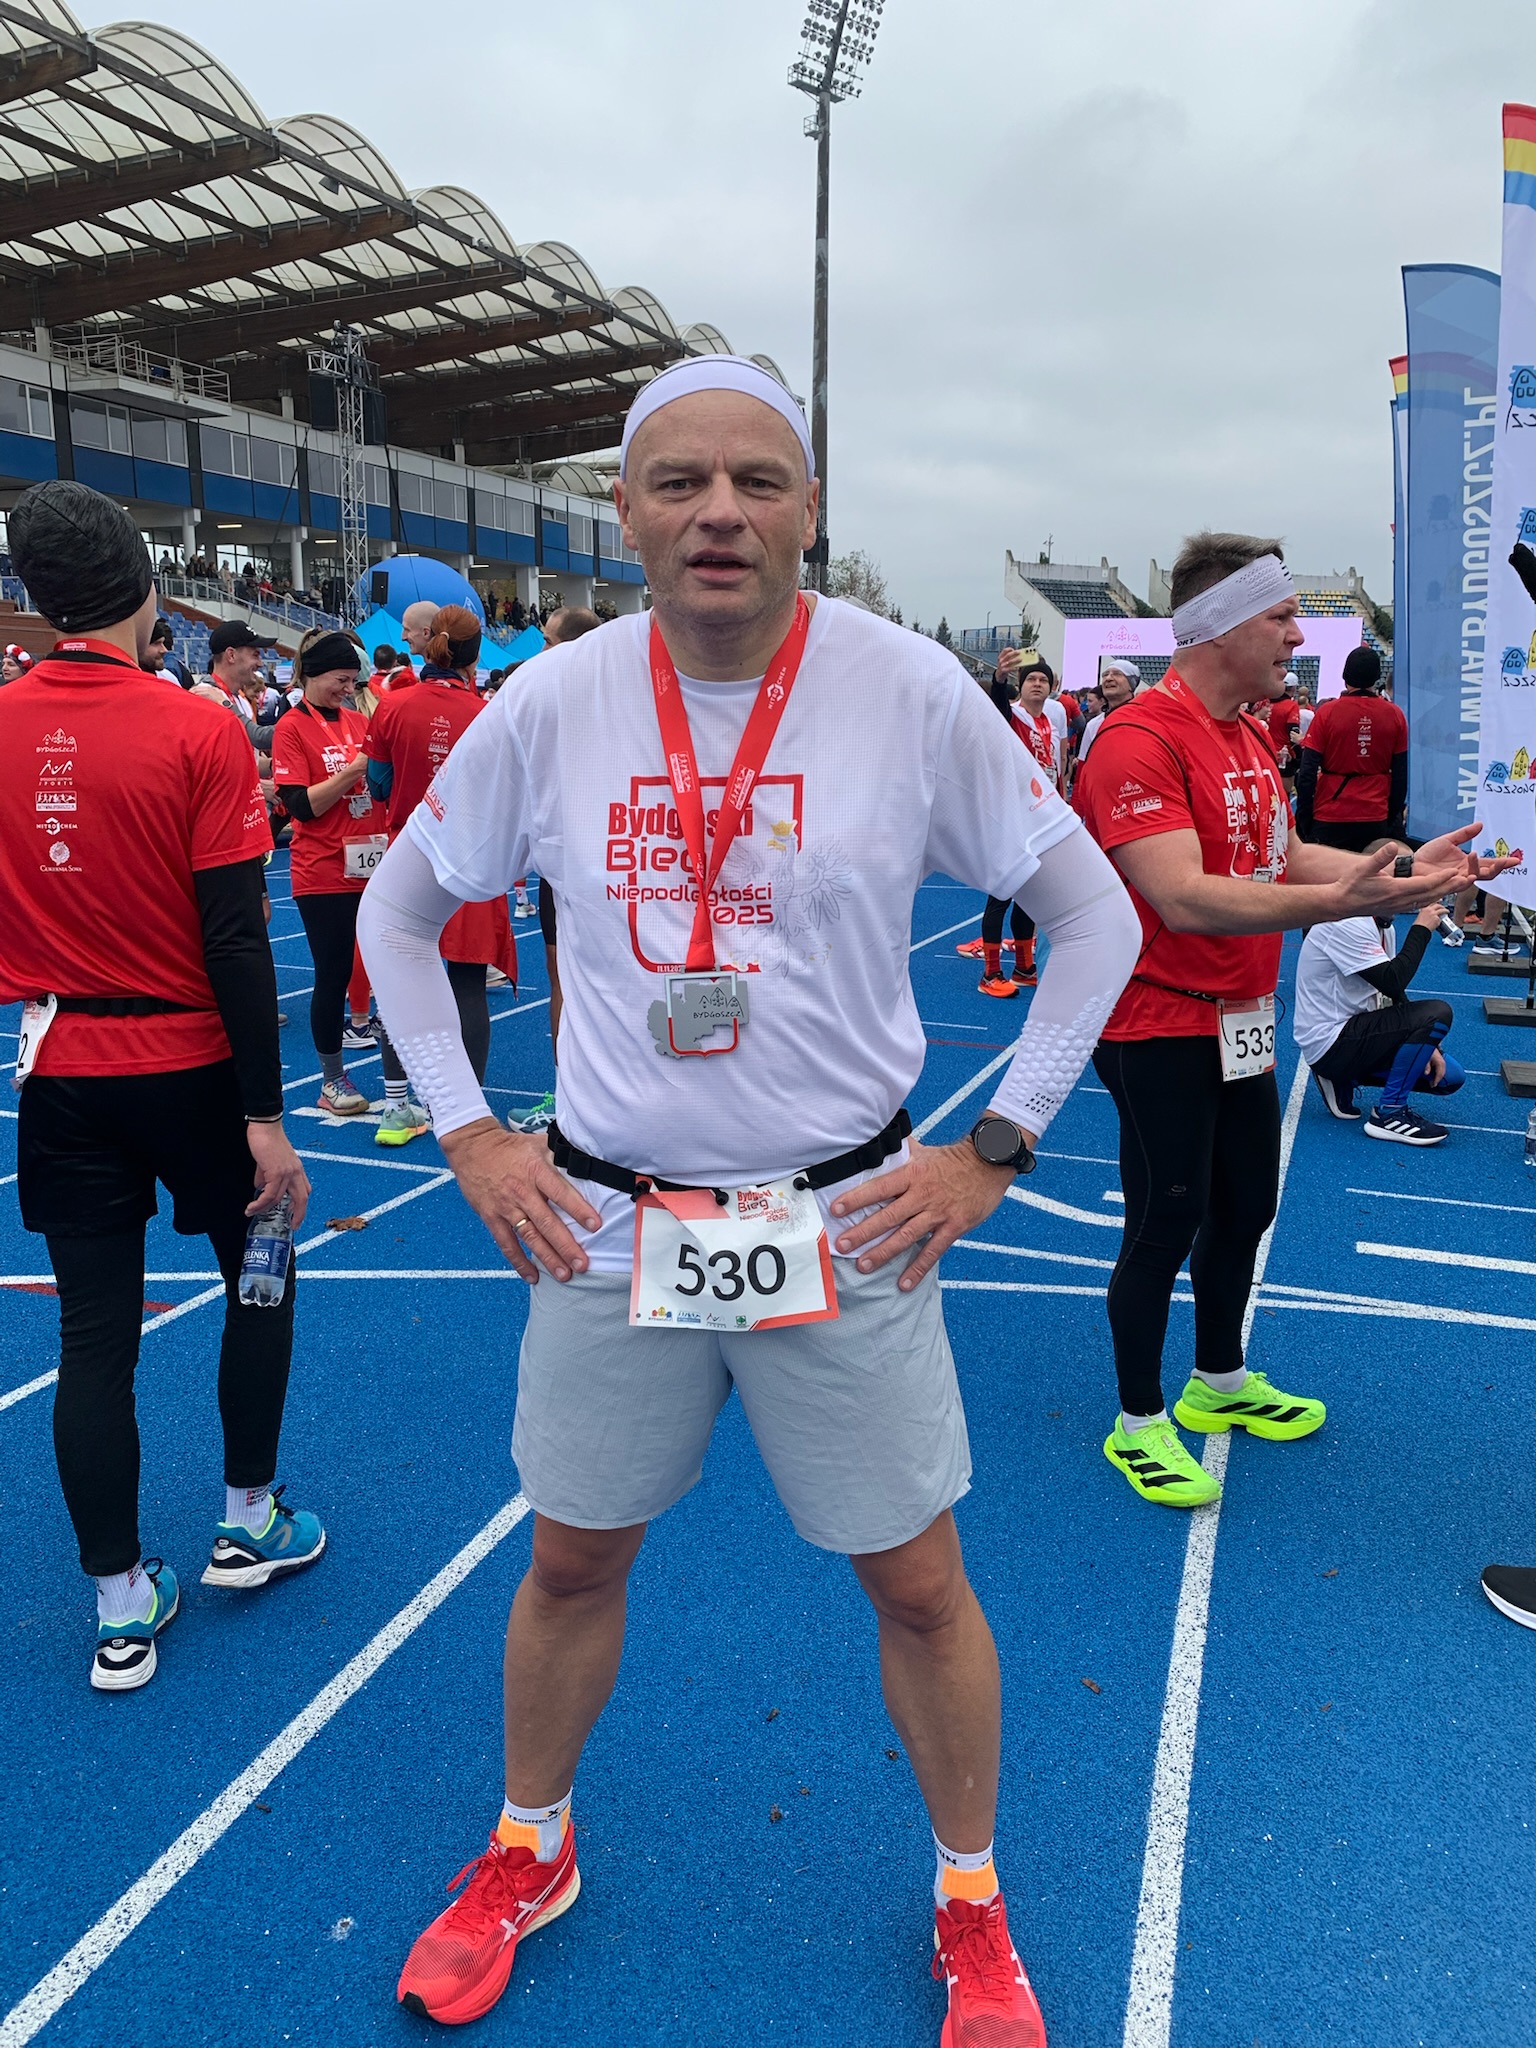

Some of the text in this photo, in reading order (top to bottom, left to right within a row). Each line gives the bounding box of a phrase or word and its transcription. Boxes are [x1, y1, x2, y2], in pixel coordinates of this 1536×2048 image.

[608, 803, 753, 840] Bydgsi
[1226, 807, 1249, 827] Bie
[696, 904, 774, 925] 025
[1235, 1025, 1274, 1059] 533
[738, 1199, 769, 1213] Bieg
[766, 1212, 790, 1223] 2025
[675, 1243, 786, 1301] 530
